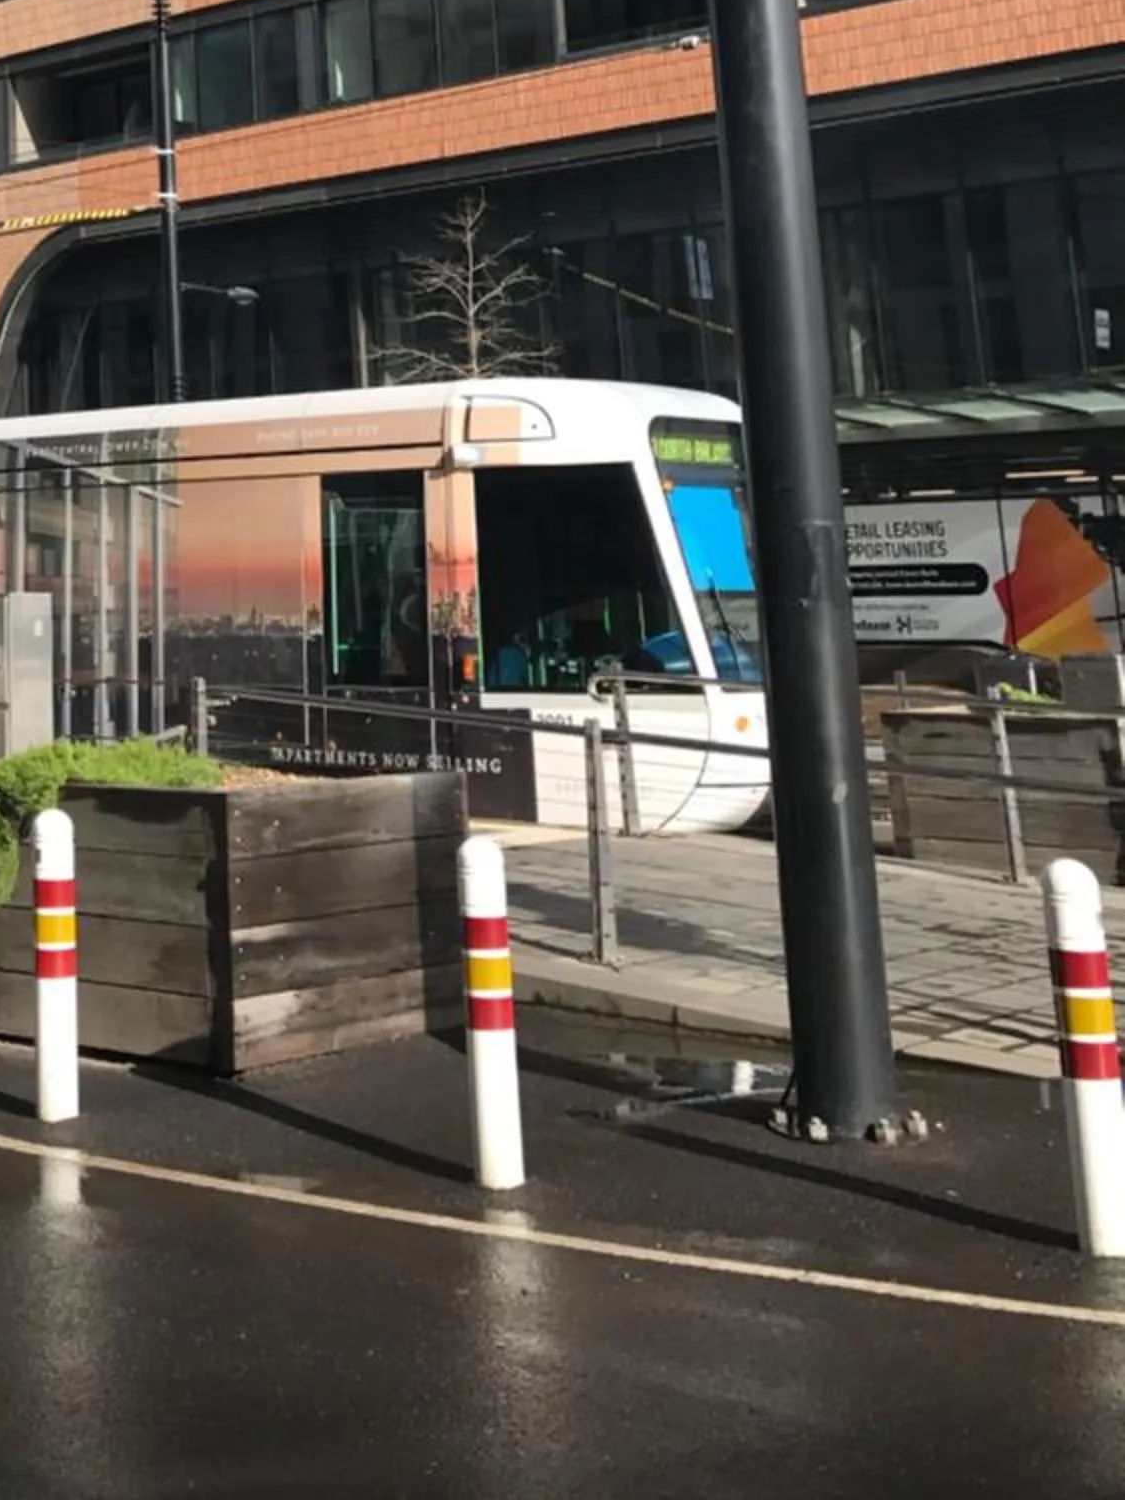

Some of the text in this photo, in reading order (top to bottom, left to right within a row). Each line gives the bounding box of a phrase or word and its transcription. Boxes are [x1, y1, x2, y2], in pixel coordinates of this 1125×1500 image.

[845, 520, 945, 539] ETAIL LEASING
[846, 540, 948, 558] PPORTUNITIES
[381, 752, 420, 769] NOW
